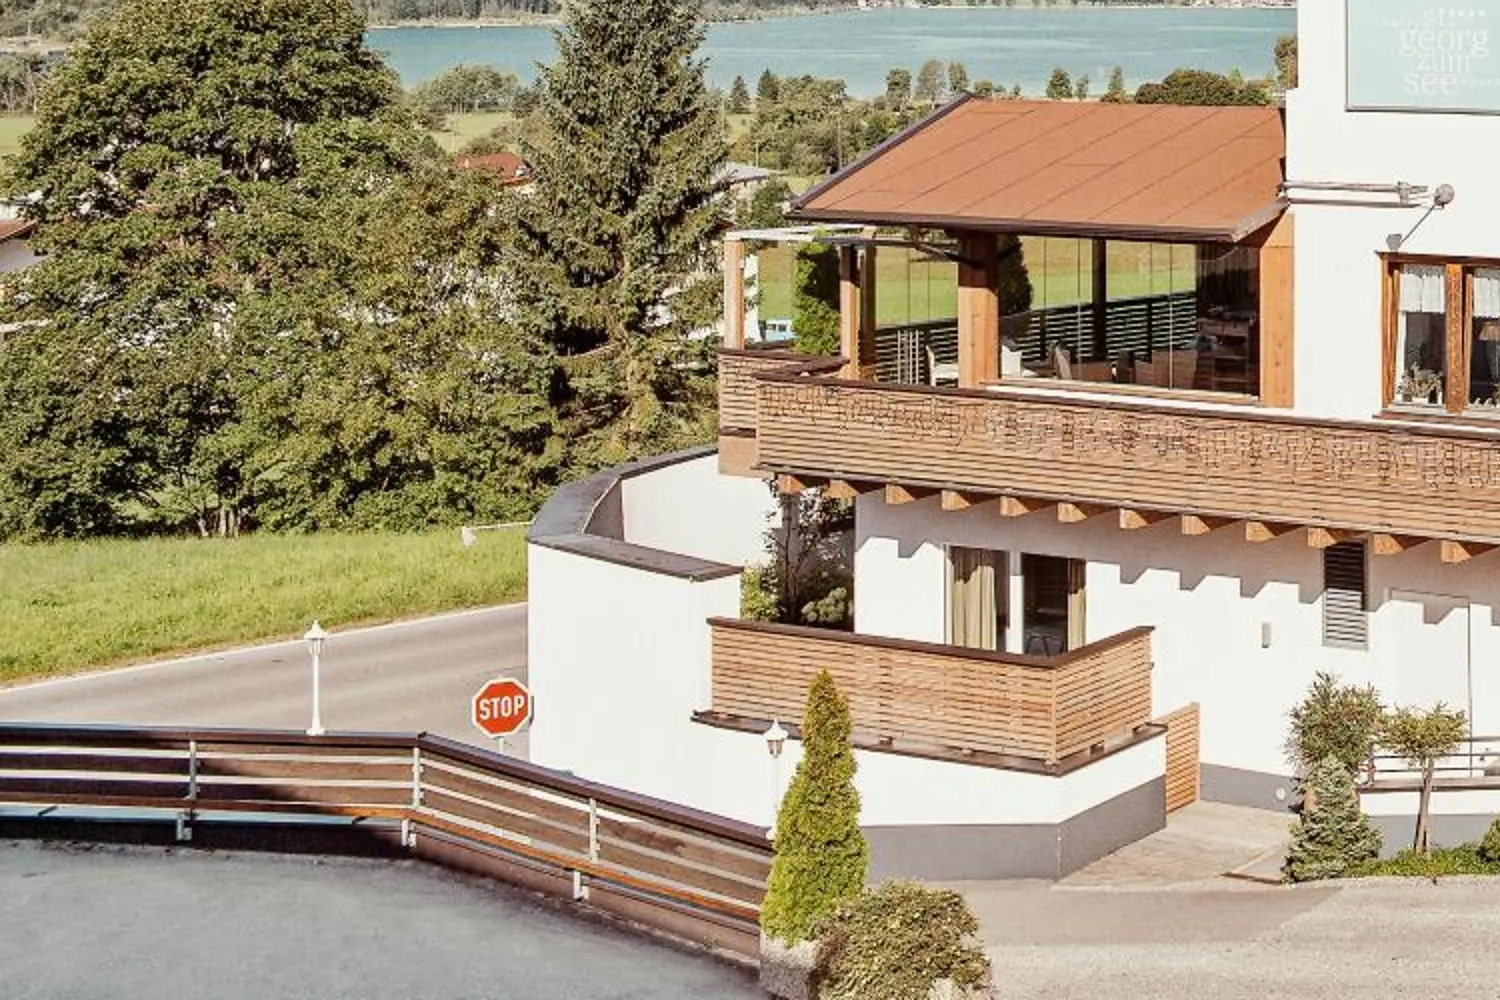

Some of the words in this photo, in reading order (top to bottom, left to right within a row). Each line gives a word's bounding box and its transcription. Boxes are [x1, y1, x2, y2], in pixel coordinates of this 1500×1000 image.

[1395, 27, 1491, 58] georg
[1417, 53, 1471, 74] zum
[1401, 72, 1458, 96] see
[479, 696, 525, 720] STOP
